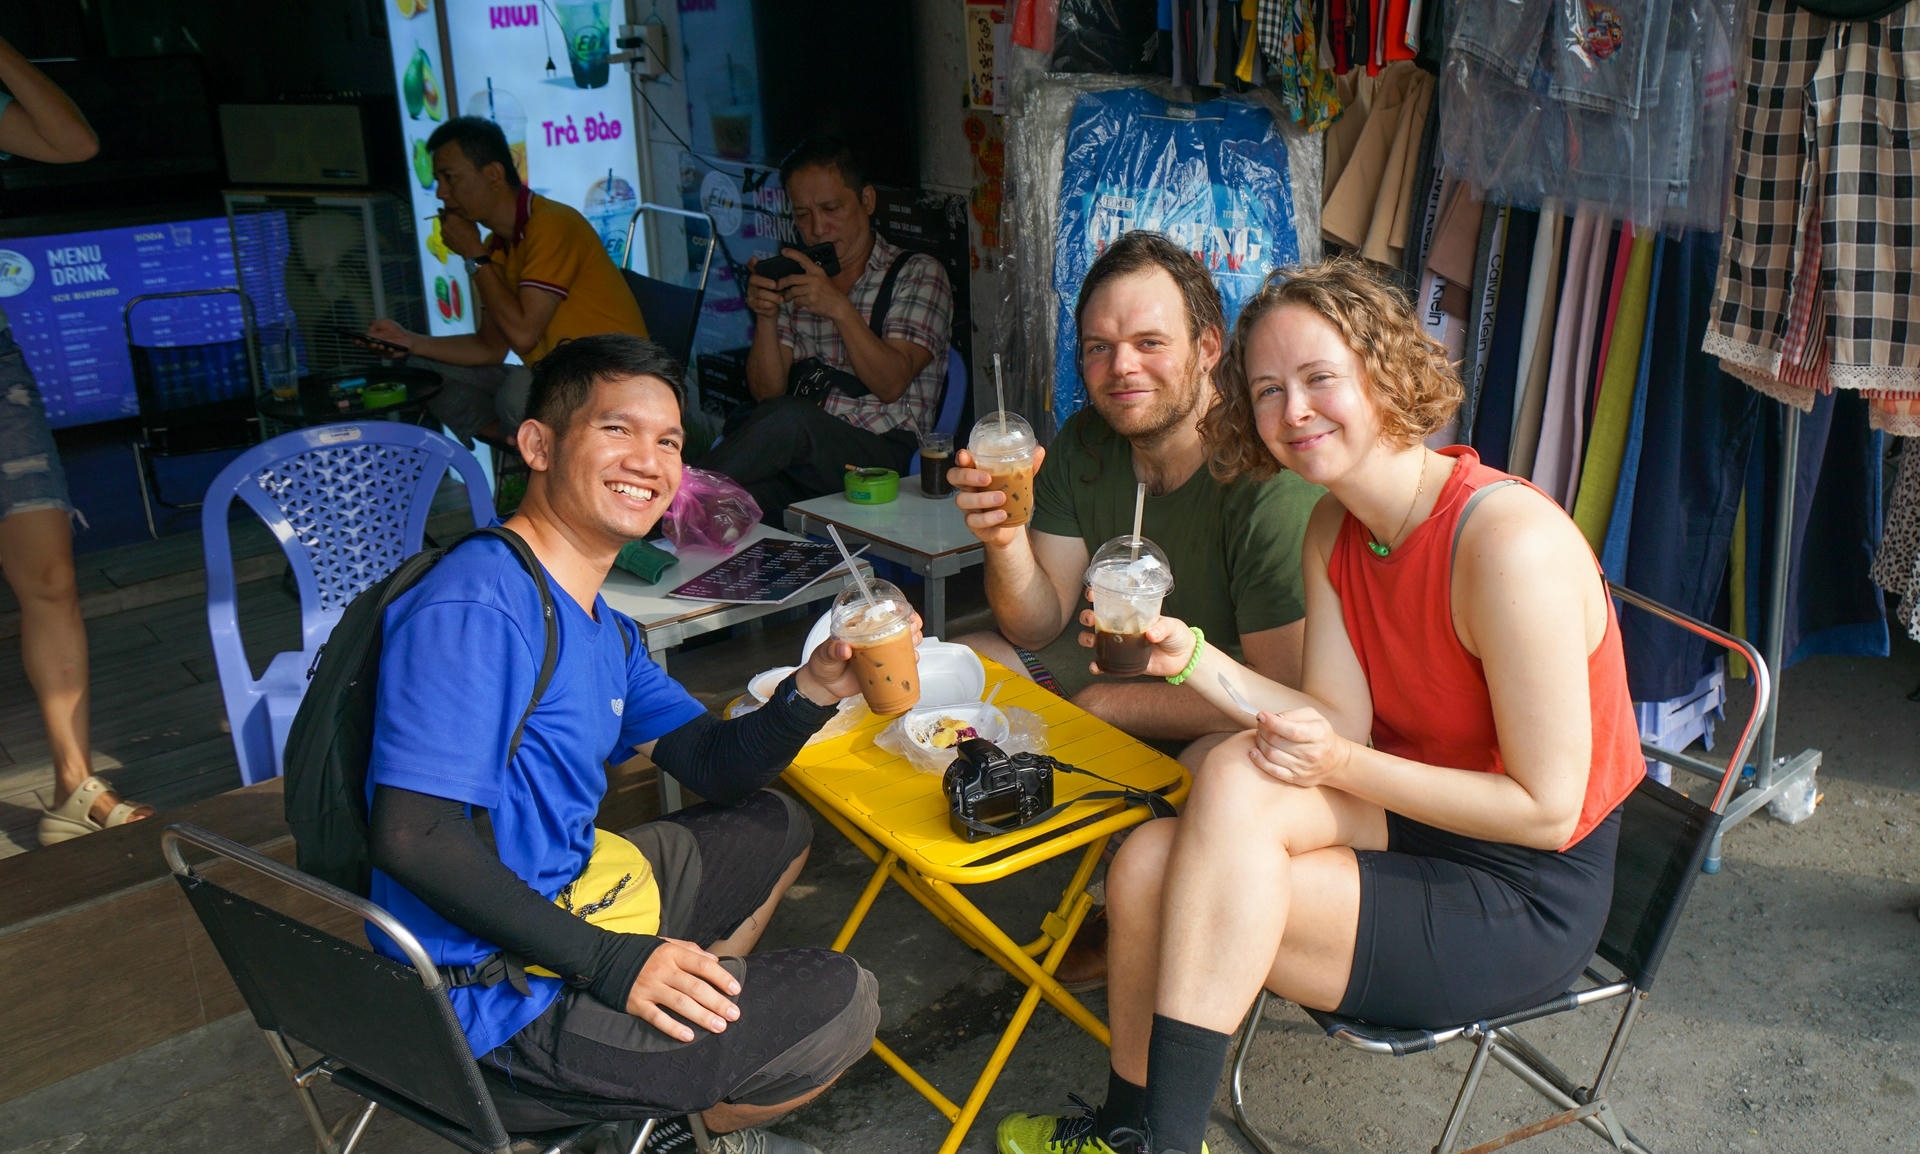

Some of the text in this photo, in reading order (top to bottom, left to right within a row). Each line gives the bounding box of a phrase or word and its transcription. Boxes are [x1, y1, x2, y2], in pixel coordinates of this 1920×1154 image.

[489, 4, 539, 29] KIWI
[542, 112, 622, 147] Trà Đào
[46, 244, 102, 267] MENU
[51, 262, 111, 287] DRINK
[1478, 253, 1502, 352] Calvin Klein
